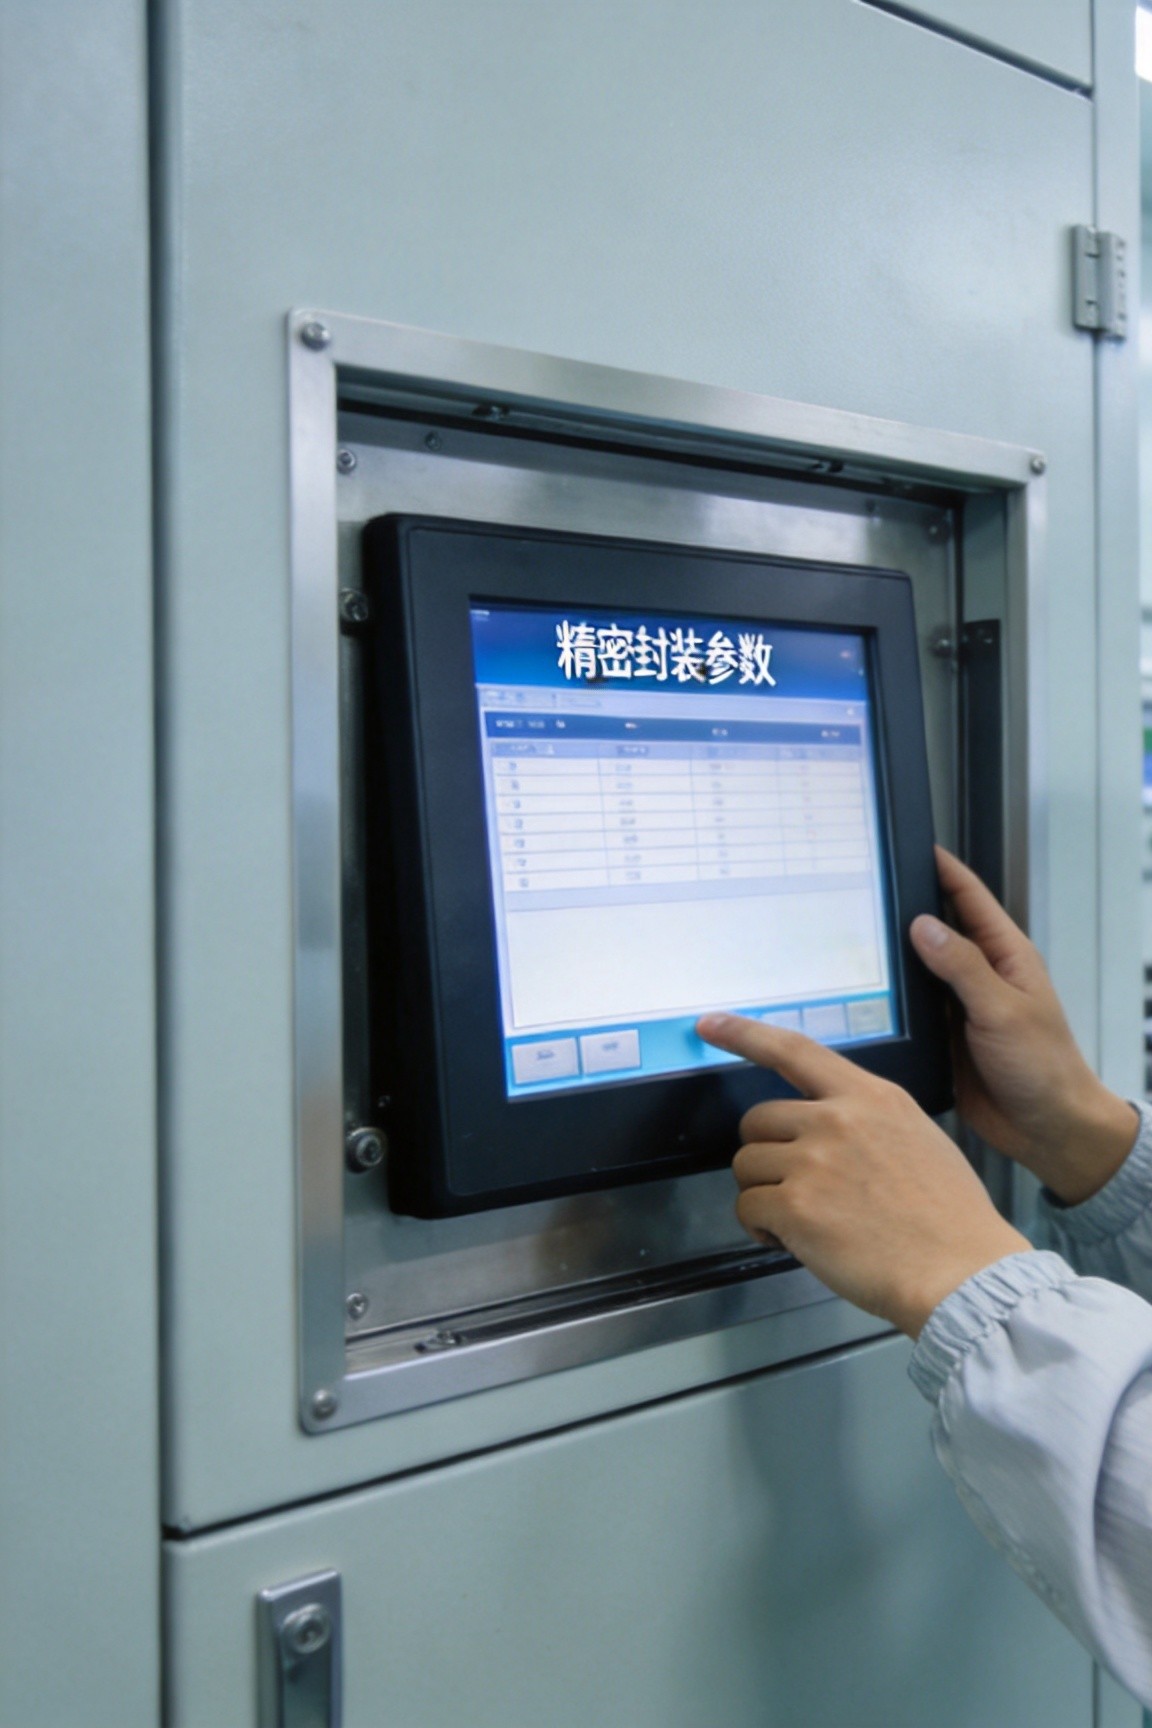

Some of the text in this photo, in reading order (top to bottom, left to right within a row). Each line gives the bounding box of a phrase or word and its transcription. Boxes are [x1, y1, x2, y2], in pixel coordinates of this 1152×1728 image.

[556, 620, 776, 686] 精密封装参数
